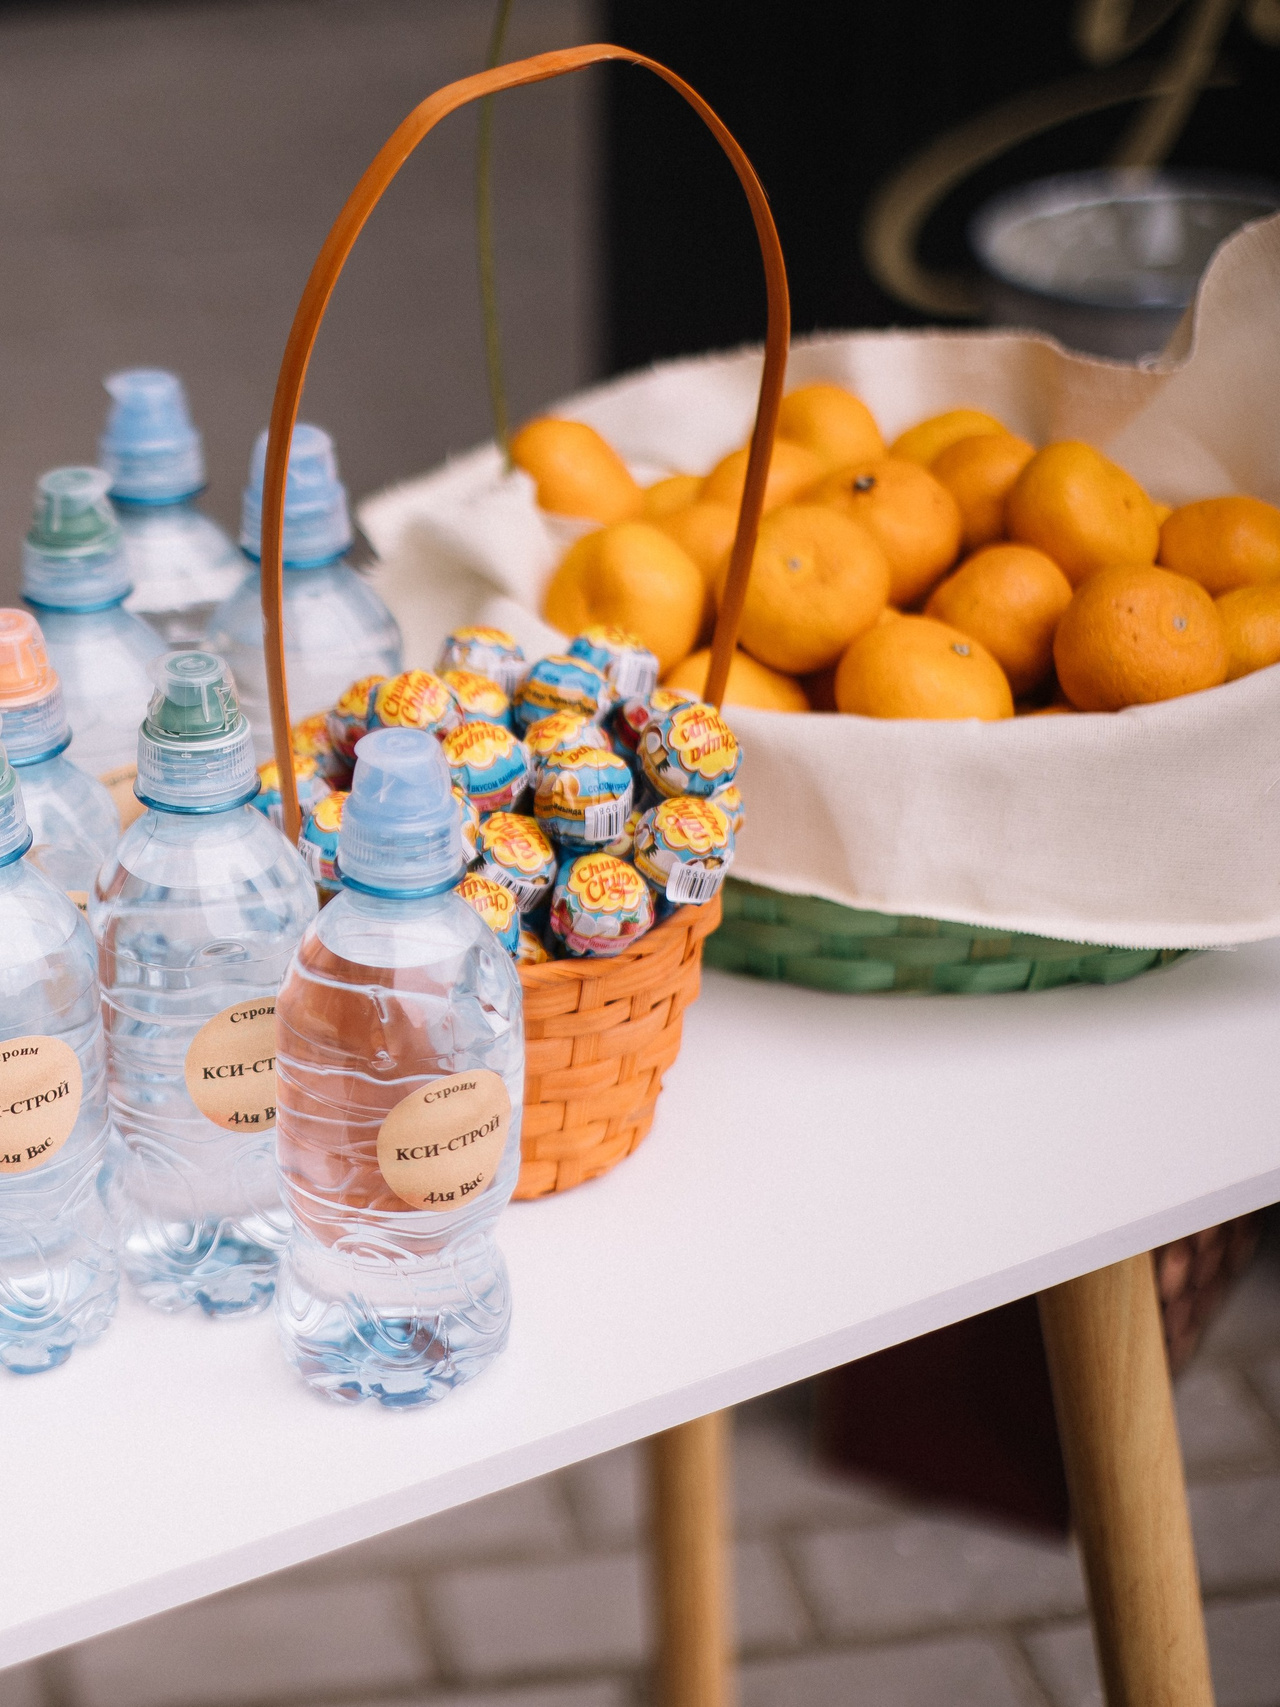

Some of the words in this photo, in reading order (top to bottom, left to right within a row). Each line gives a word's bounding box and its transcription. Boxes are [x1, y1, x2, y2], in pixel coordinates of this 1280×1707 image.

[586, 872, 639, 902] Chups
[230, 1006, 276, 1023] Строи
[202, 1056, 276, 1080] КСИ-СТ
[423, 1081, 477, 1104] Строим
[228, 1111, 261, 1124] Для
[25, 1136, 54, 1160] Вас
[395, 1113, 500, 1161] КСИ-СТРОЙ
[423, 1191, 455, 1204] Для
[459, 1172, 485, 1197] Вас
